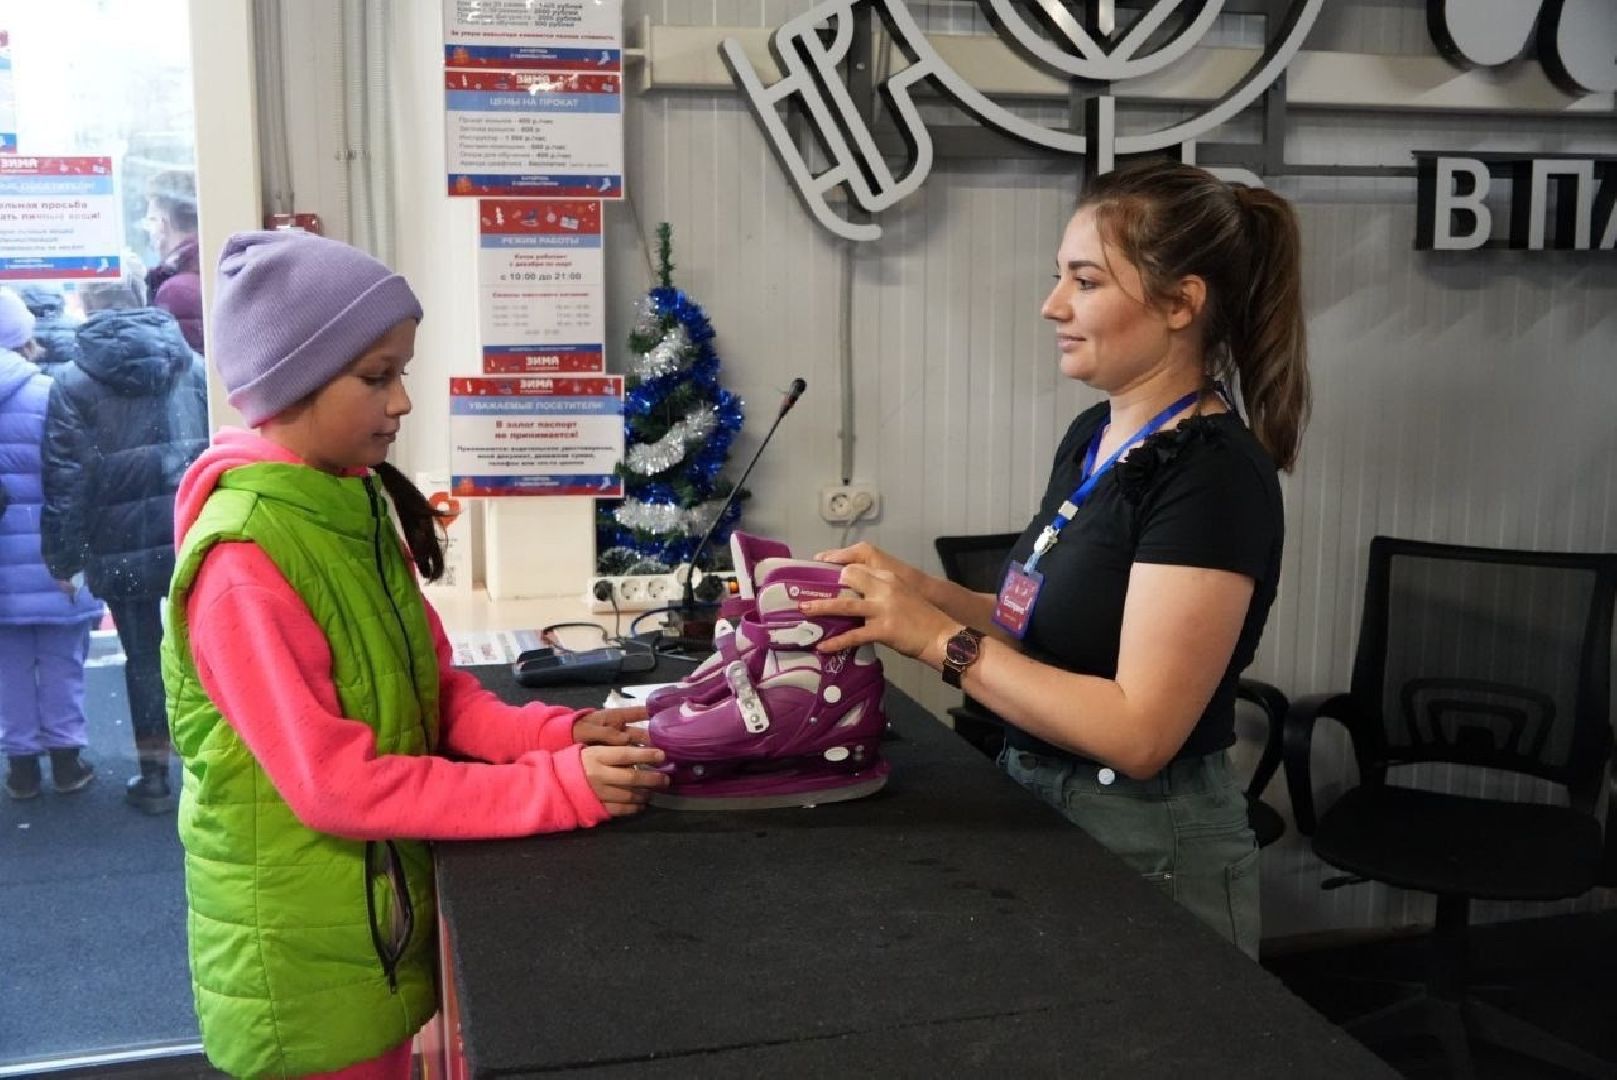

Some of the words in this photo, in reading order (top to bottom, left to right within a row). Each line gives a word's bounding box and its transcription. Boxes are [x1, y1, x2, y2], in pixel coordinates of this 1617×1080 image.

[490, 97, 521, 107] ЦЕНЫ
[523, 97, 537, 107] НА
[538, 97, 578, 108] ПРОКАТ
[41, 201, 88, 210] просьба
[1433, 156, 1492, 250] В
[509, 271, 537, 281] 10:00
[538, 273, 553, 281] до
[554, 271, 582, 281] 21:00
[525, 356, 560, 367] ЗИМА
[519, 378, 554, 389] ЗИМА
[495, 420, 502, 429] В
[506, 421, 534, 429] залог
[537, 421, 578, 430] паспорт
[509, 431, 579, 441] принимается!
